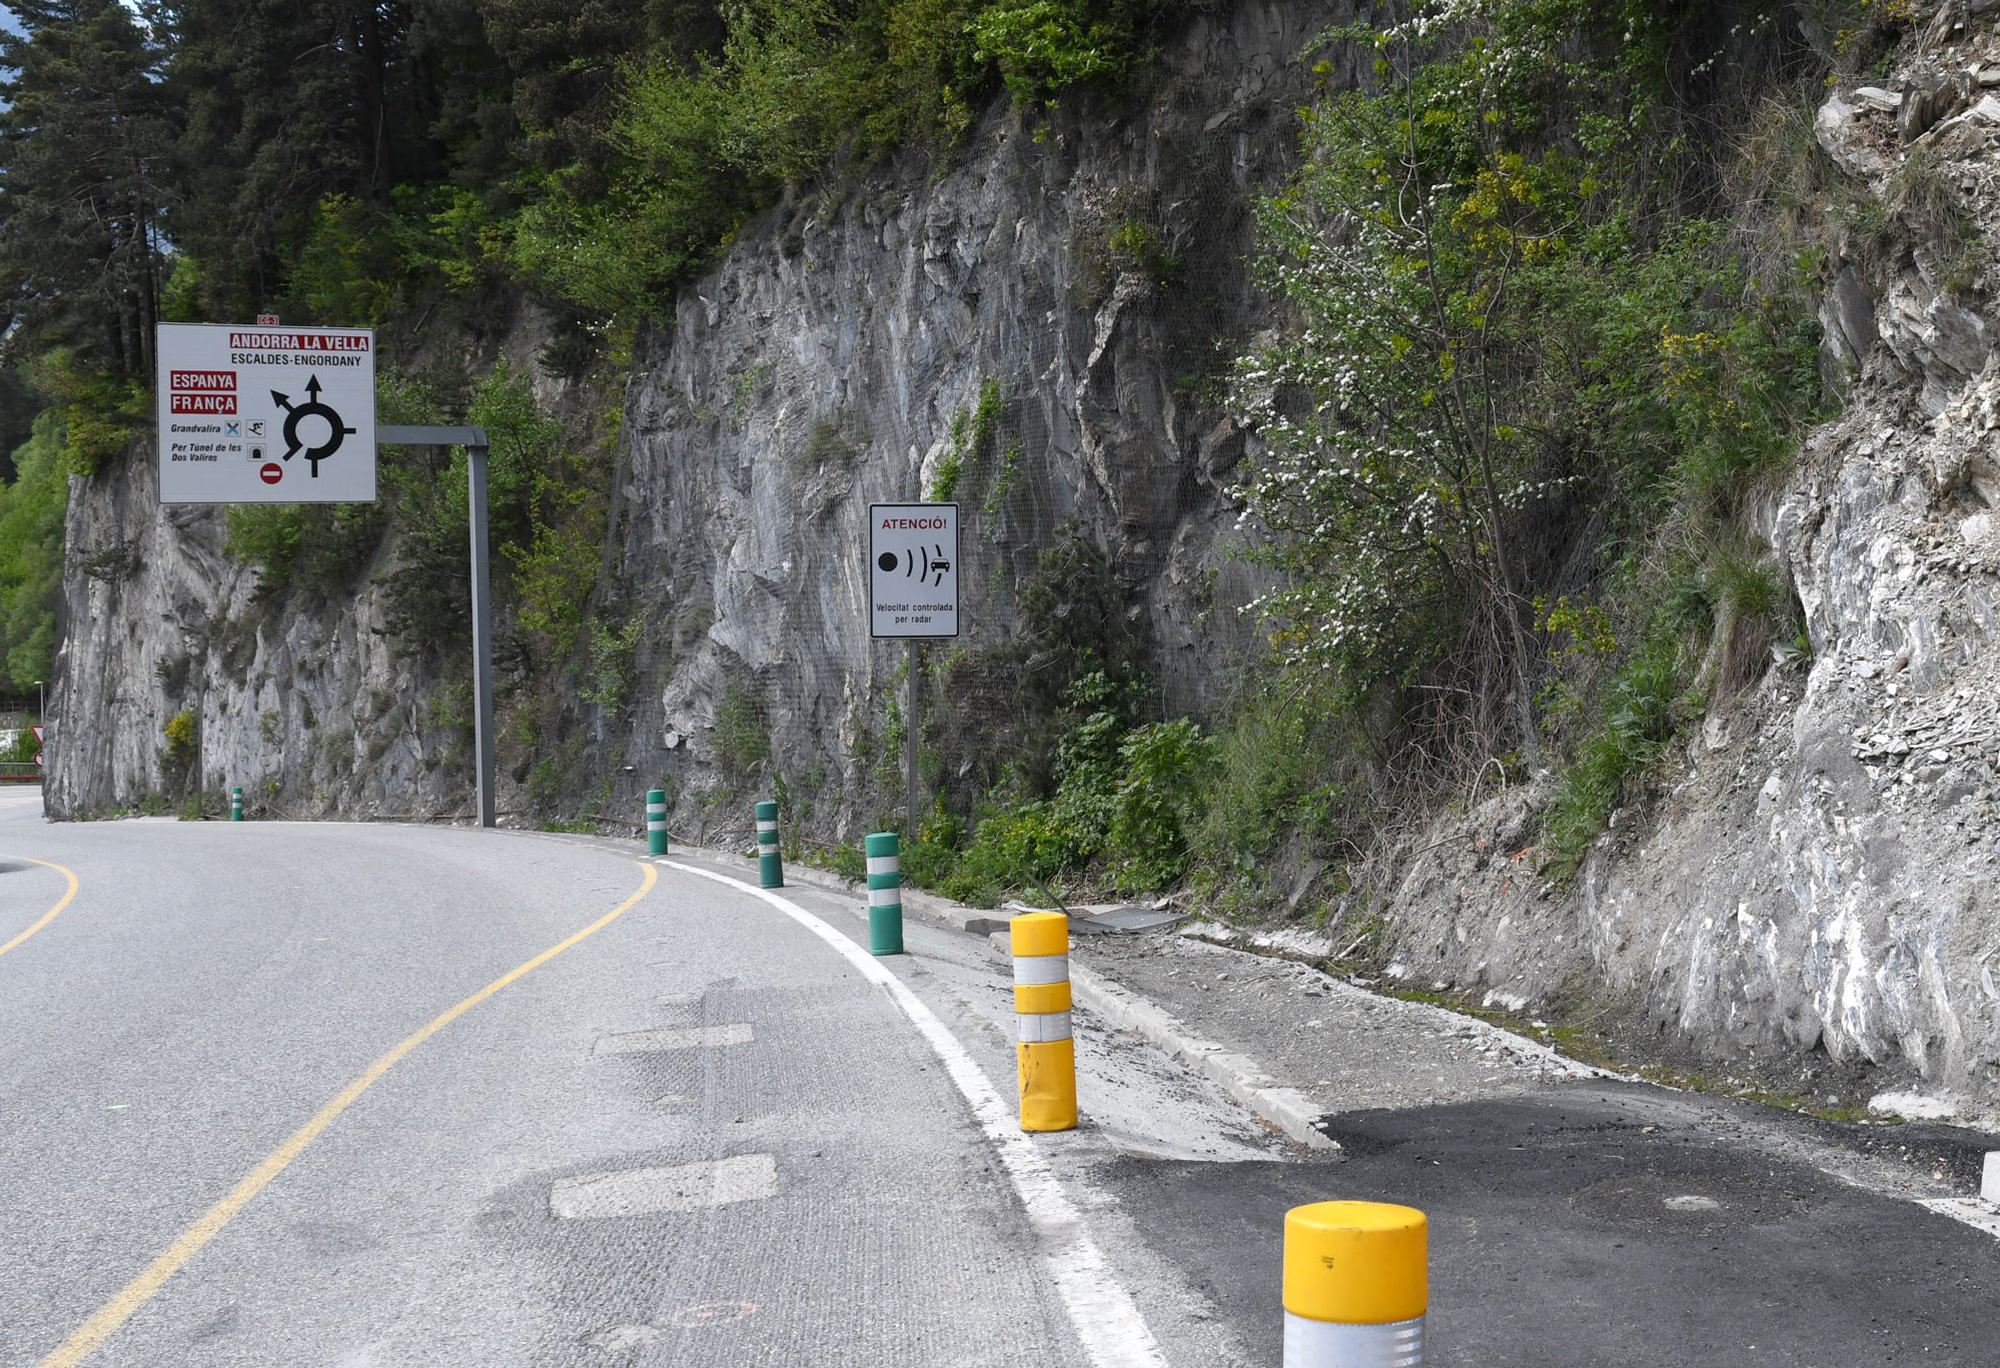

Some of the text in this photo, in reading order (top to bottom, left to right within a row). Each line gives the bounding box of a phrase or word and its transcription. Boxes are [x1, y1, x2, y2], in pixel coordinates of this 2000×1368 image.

[231, 334, 367, 351] ANDORRA LA VELLA
[231, 353, 361, 367] ESCALDES-ENGORDANY
[173, 374, 234, 388] ESPANYA
[172, 396, 235, 414] FRANÇA
[171, 424, 221, 433] Grandvalira
[171, 443, 187, 452] Per
[215, 443, 226, 452] de
[228, 443, 242, 452] les
[171, 453, 218, 462] Dos Valires
[882, 515, 947, 529] ATENCIÓ!
[876, 603, 953, 612] Velocitat controlada
[895, 615, 932, 625] per radar
